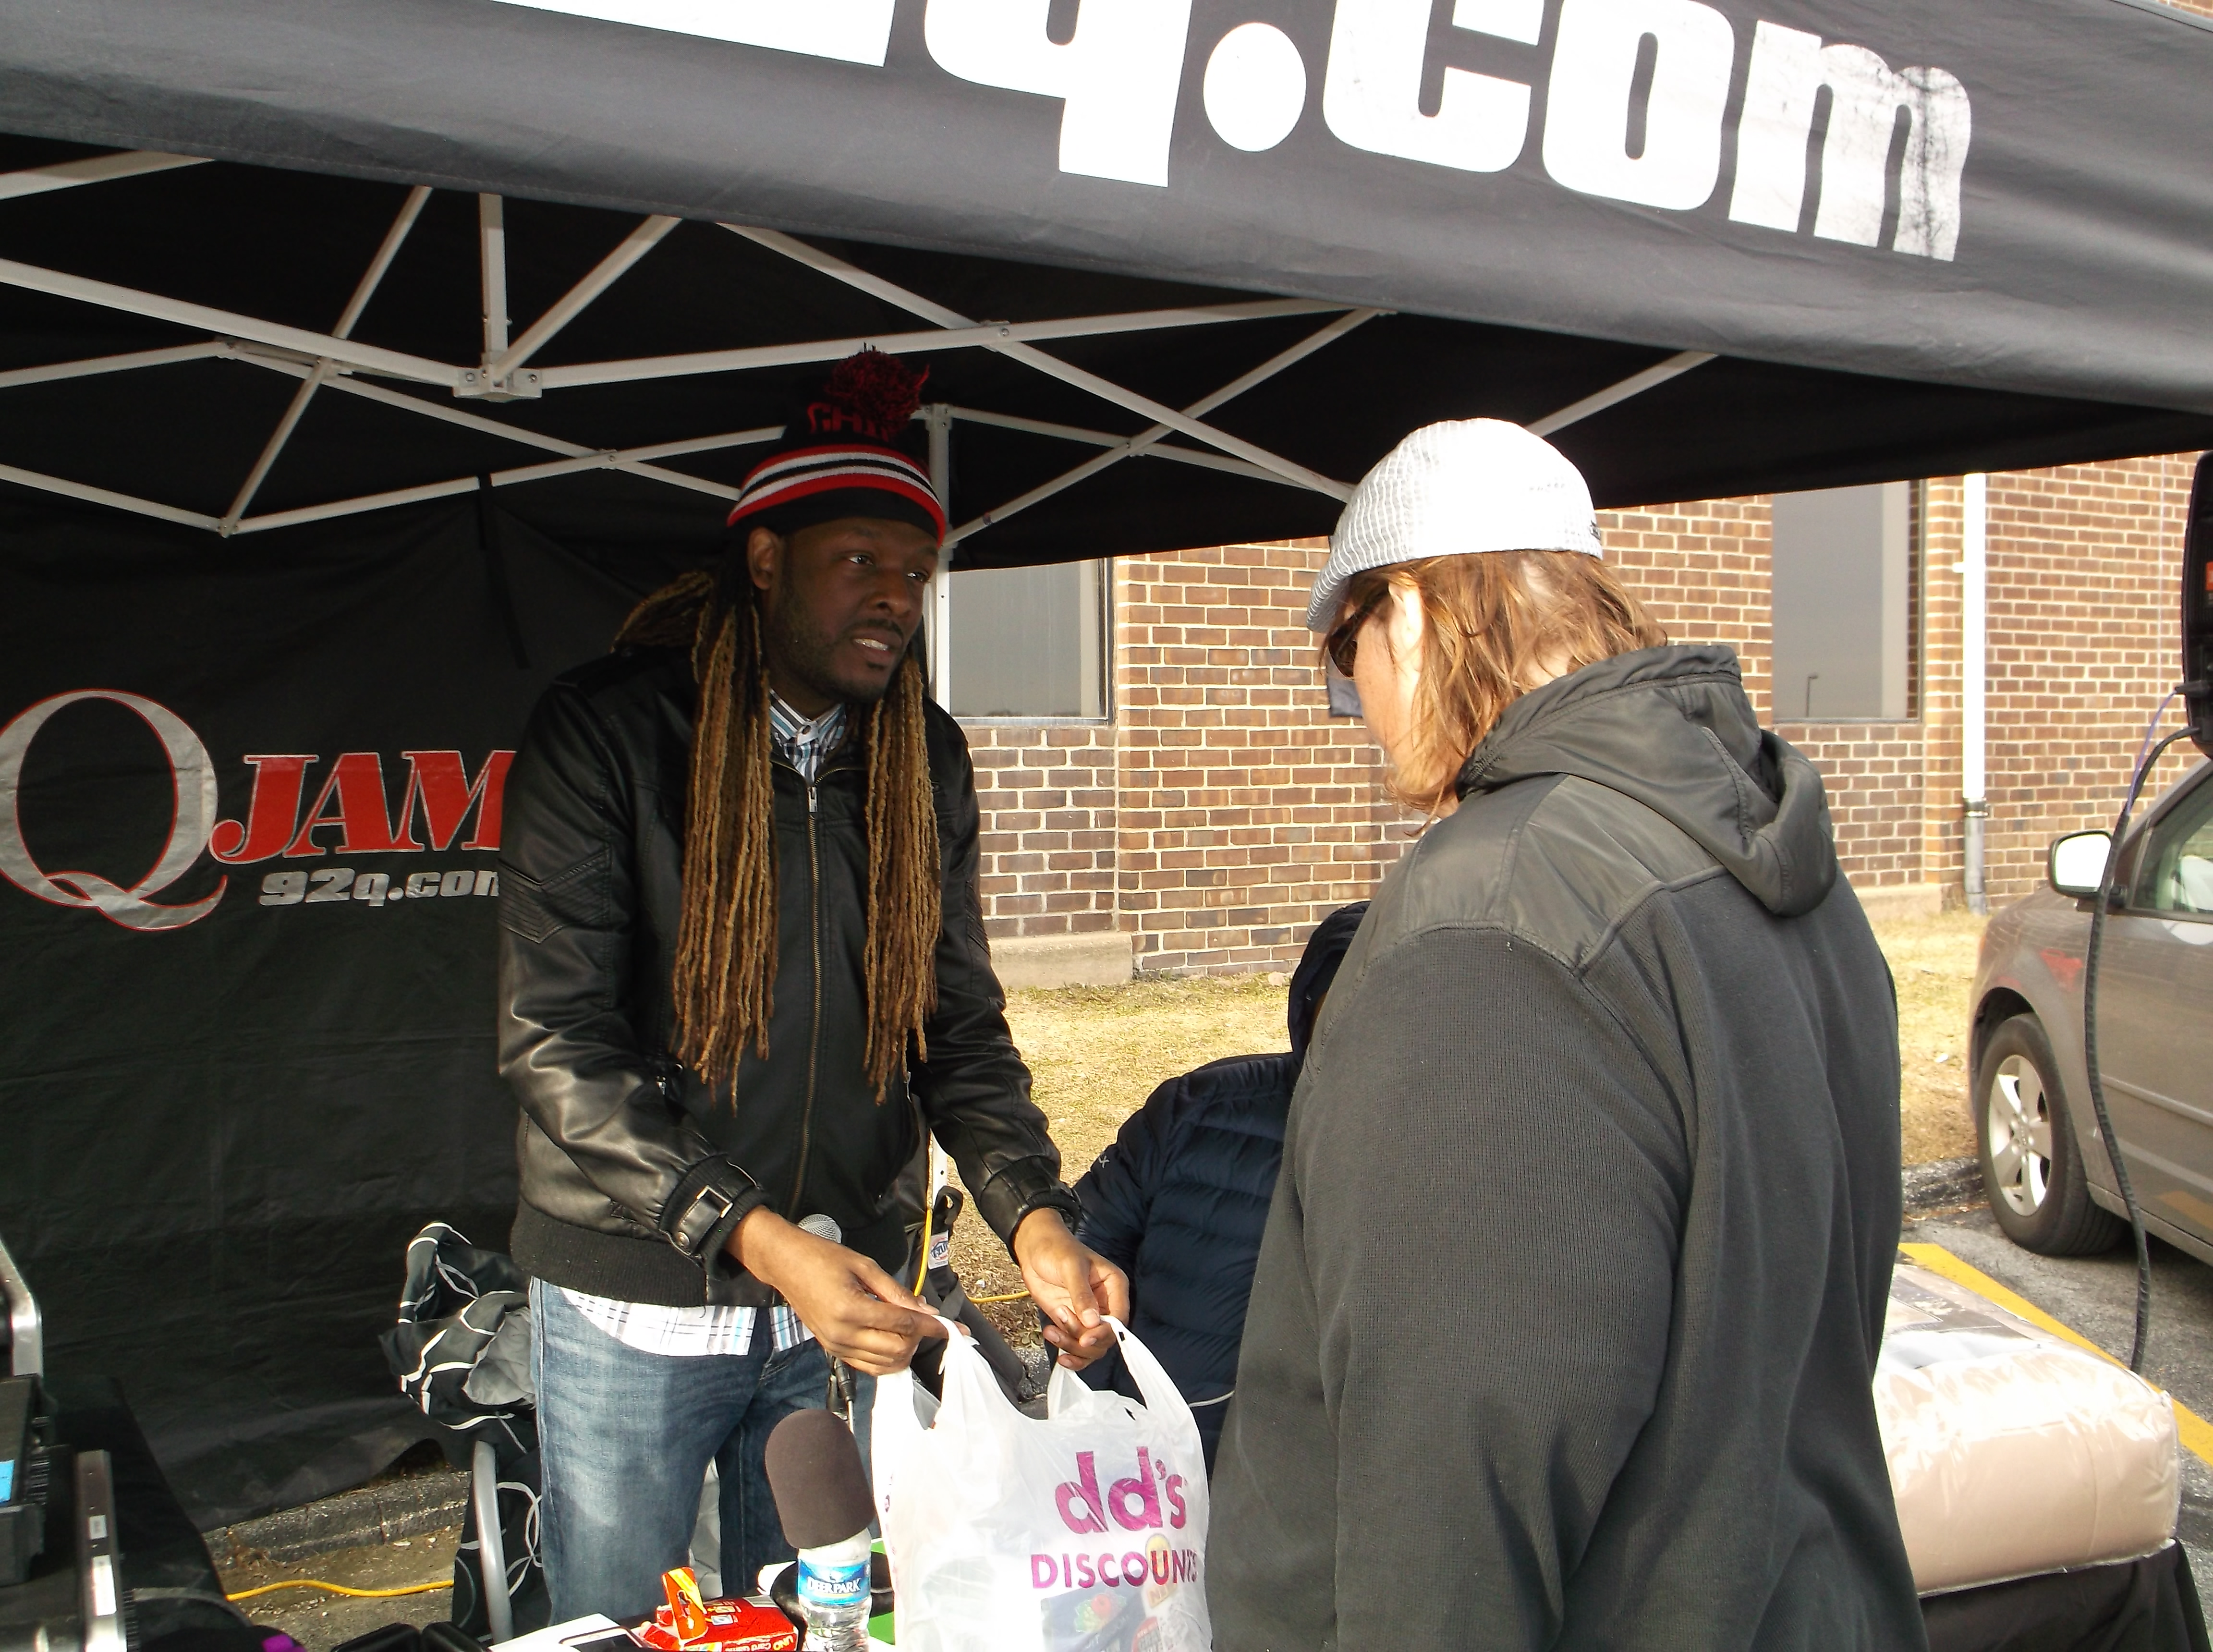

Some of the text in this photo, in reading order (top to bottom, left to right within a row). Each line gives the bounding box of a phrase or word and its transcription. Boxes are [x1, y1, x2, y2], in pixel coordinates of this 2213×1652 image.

[487, 0, 1971, 262] q.com
[1055, 1446, 1187, 1534] dd's
[807, 1576, 862, 1594] DEER PARK
[773, 1635, 794, 1651] UNO
